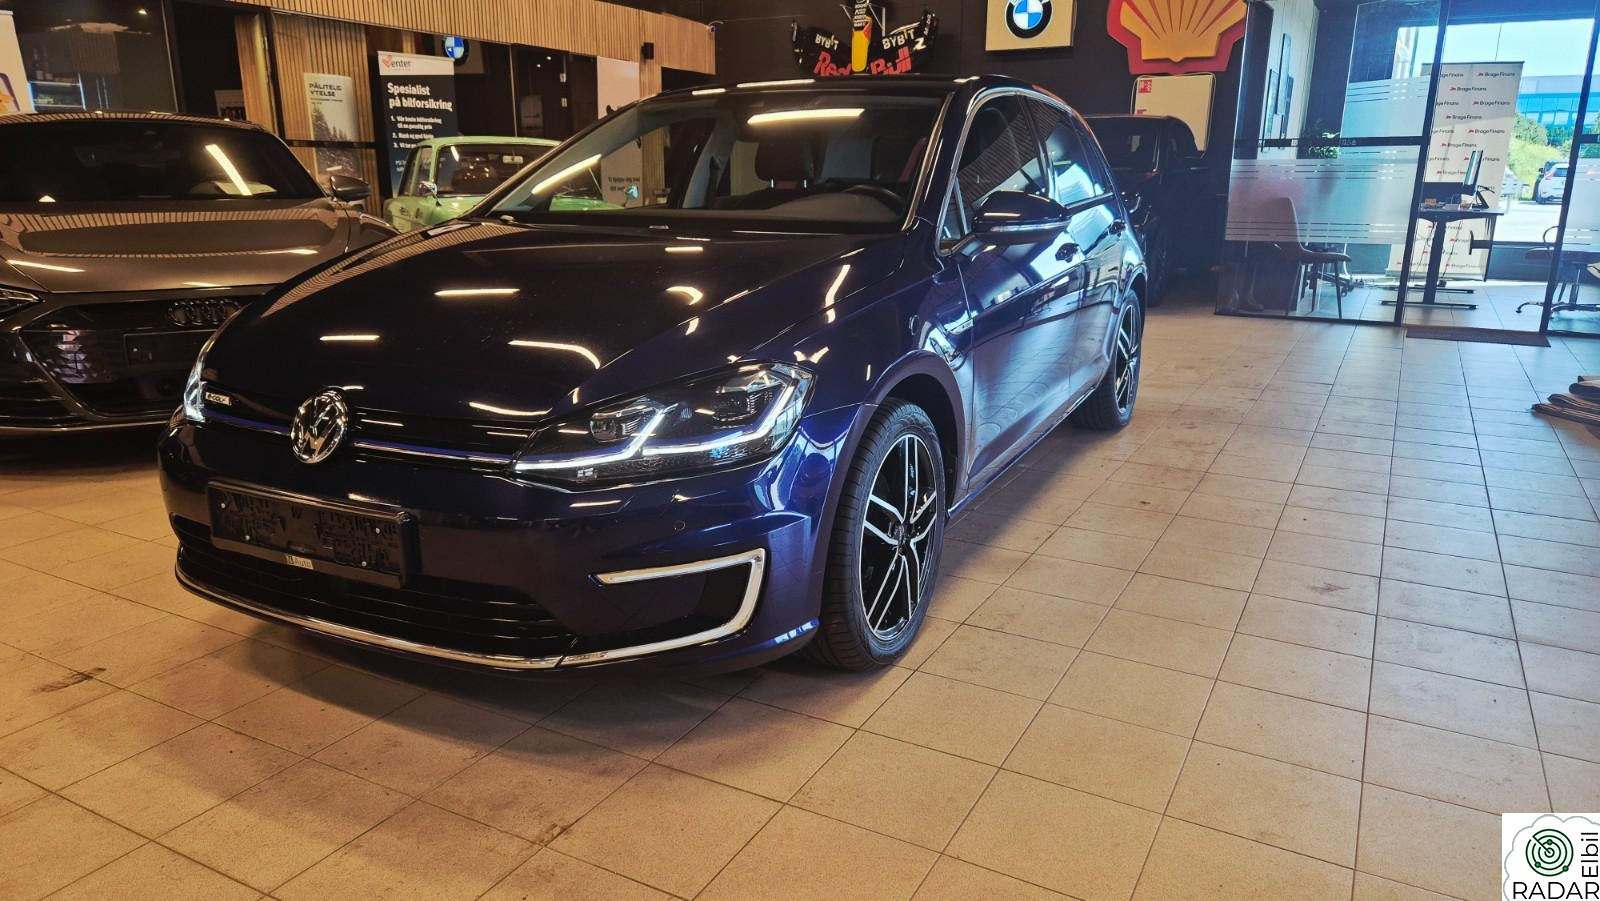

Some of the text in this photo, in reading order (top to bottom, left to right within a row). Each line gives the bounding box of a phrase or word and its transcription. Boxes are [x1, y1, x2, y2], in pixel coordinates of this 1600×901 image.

[815, 34, 839, 51] BYBIT
[882, 29, 915, 50] BYBIT
[870, 46, 912, 75] Bull
[387, 82, 430, 95] Spesialist
[389, 96, 453, 112] på bilforsikring
